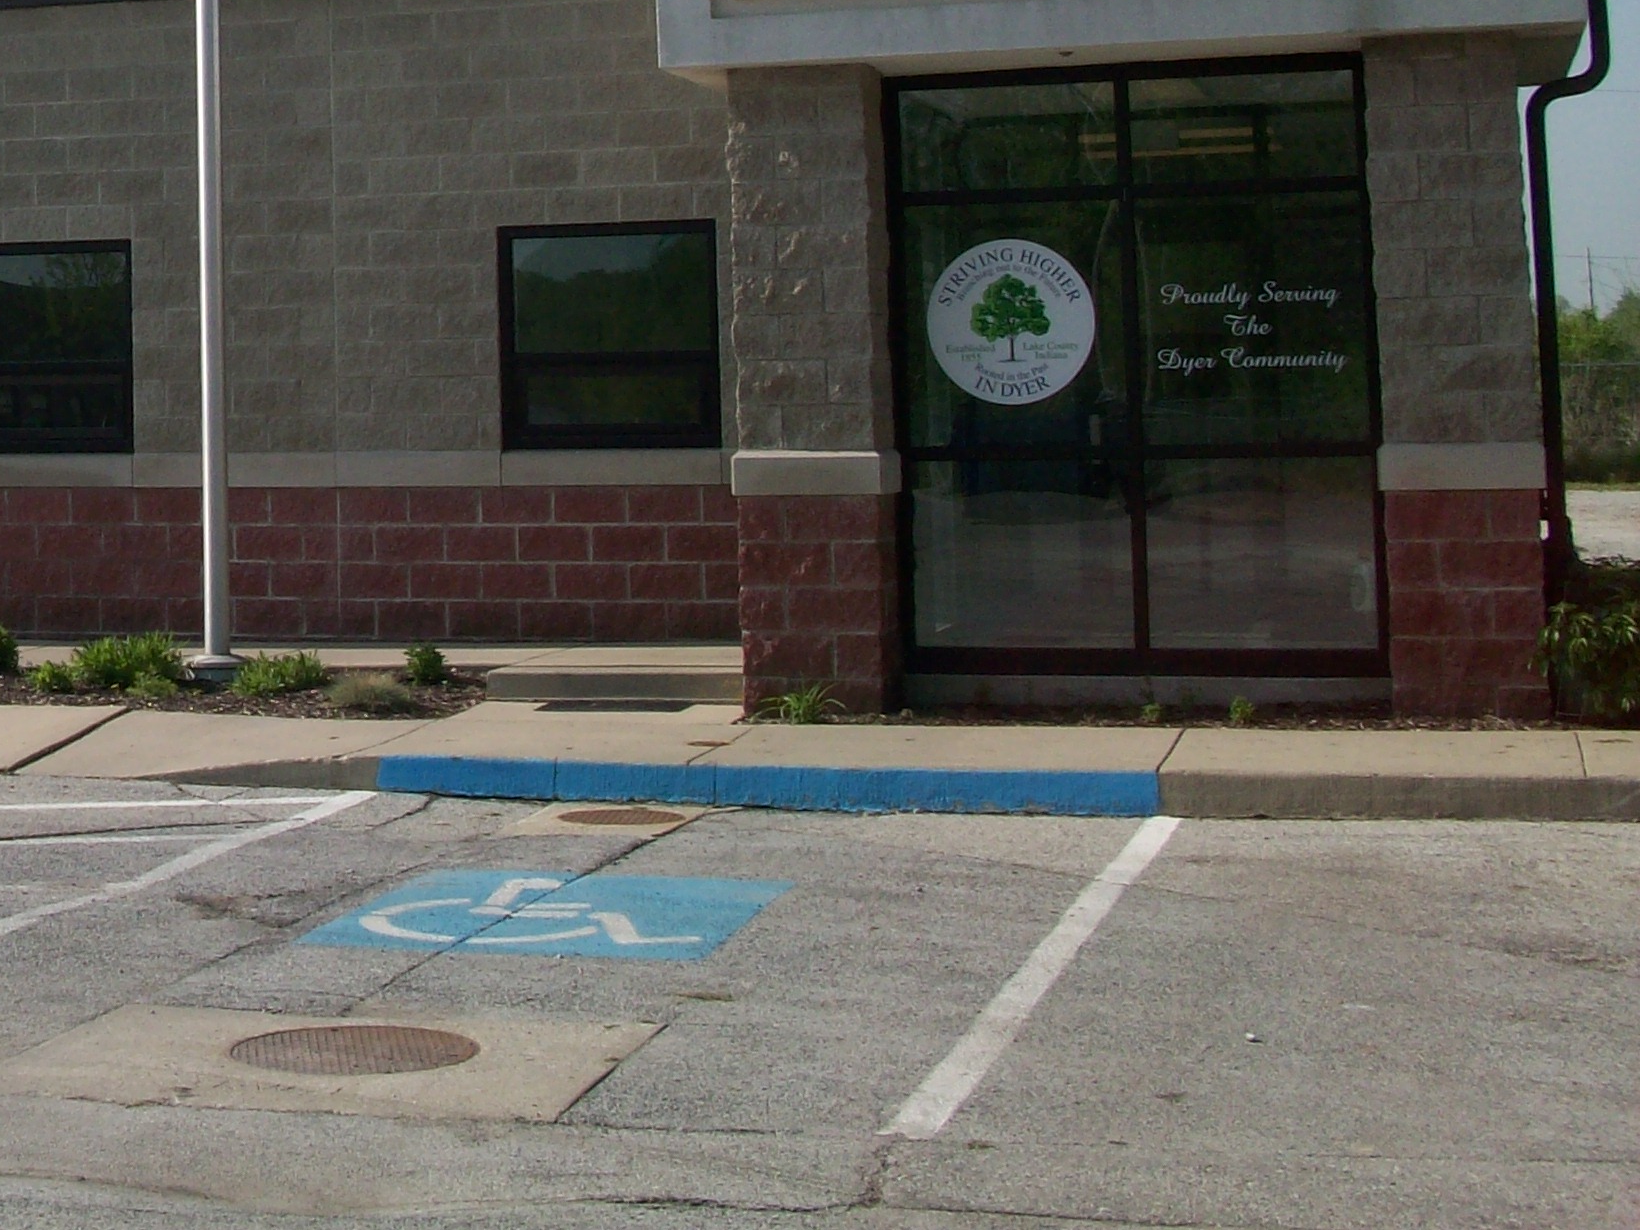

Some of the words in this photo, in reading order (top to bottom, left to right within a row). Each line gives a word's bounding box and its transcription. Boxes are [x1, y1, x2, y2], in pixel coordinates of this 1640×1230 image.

[938, 247, 1013, 307] STRIVING
[1020, 249, 1081, 303] HIGHER
[1160, 283, 1250, 310] Proudly
[1258, 280, 1340, 308] Serving
[1223, 314, 1273, 336] The
[1023, 341, 1045, 351] Lake
[1157, 348, 1217, 377] Dyer
[1220, 346, 1349, 374] Community
[974, 375, 997, 394] IN
[1000, 375, 1051, 397] DYER
